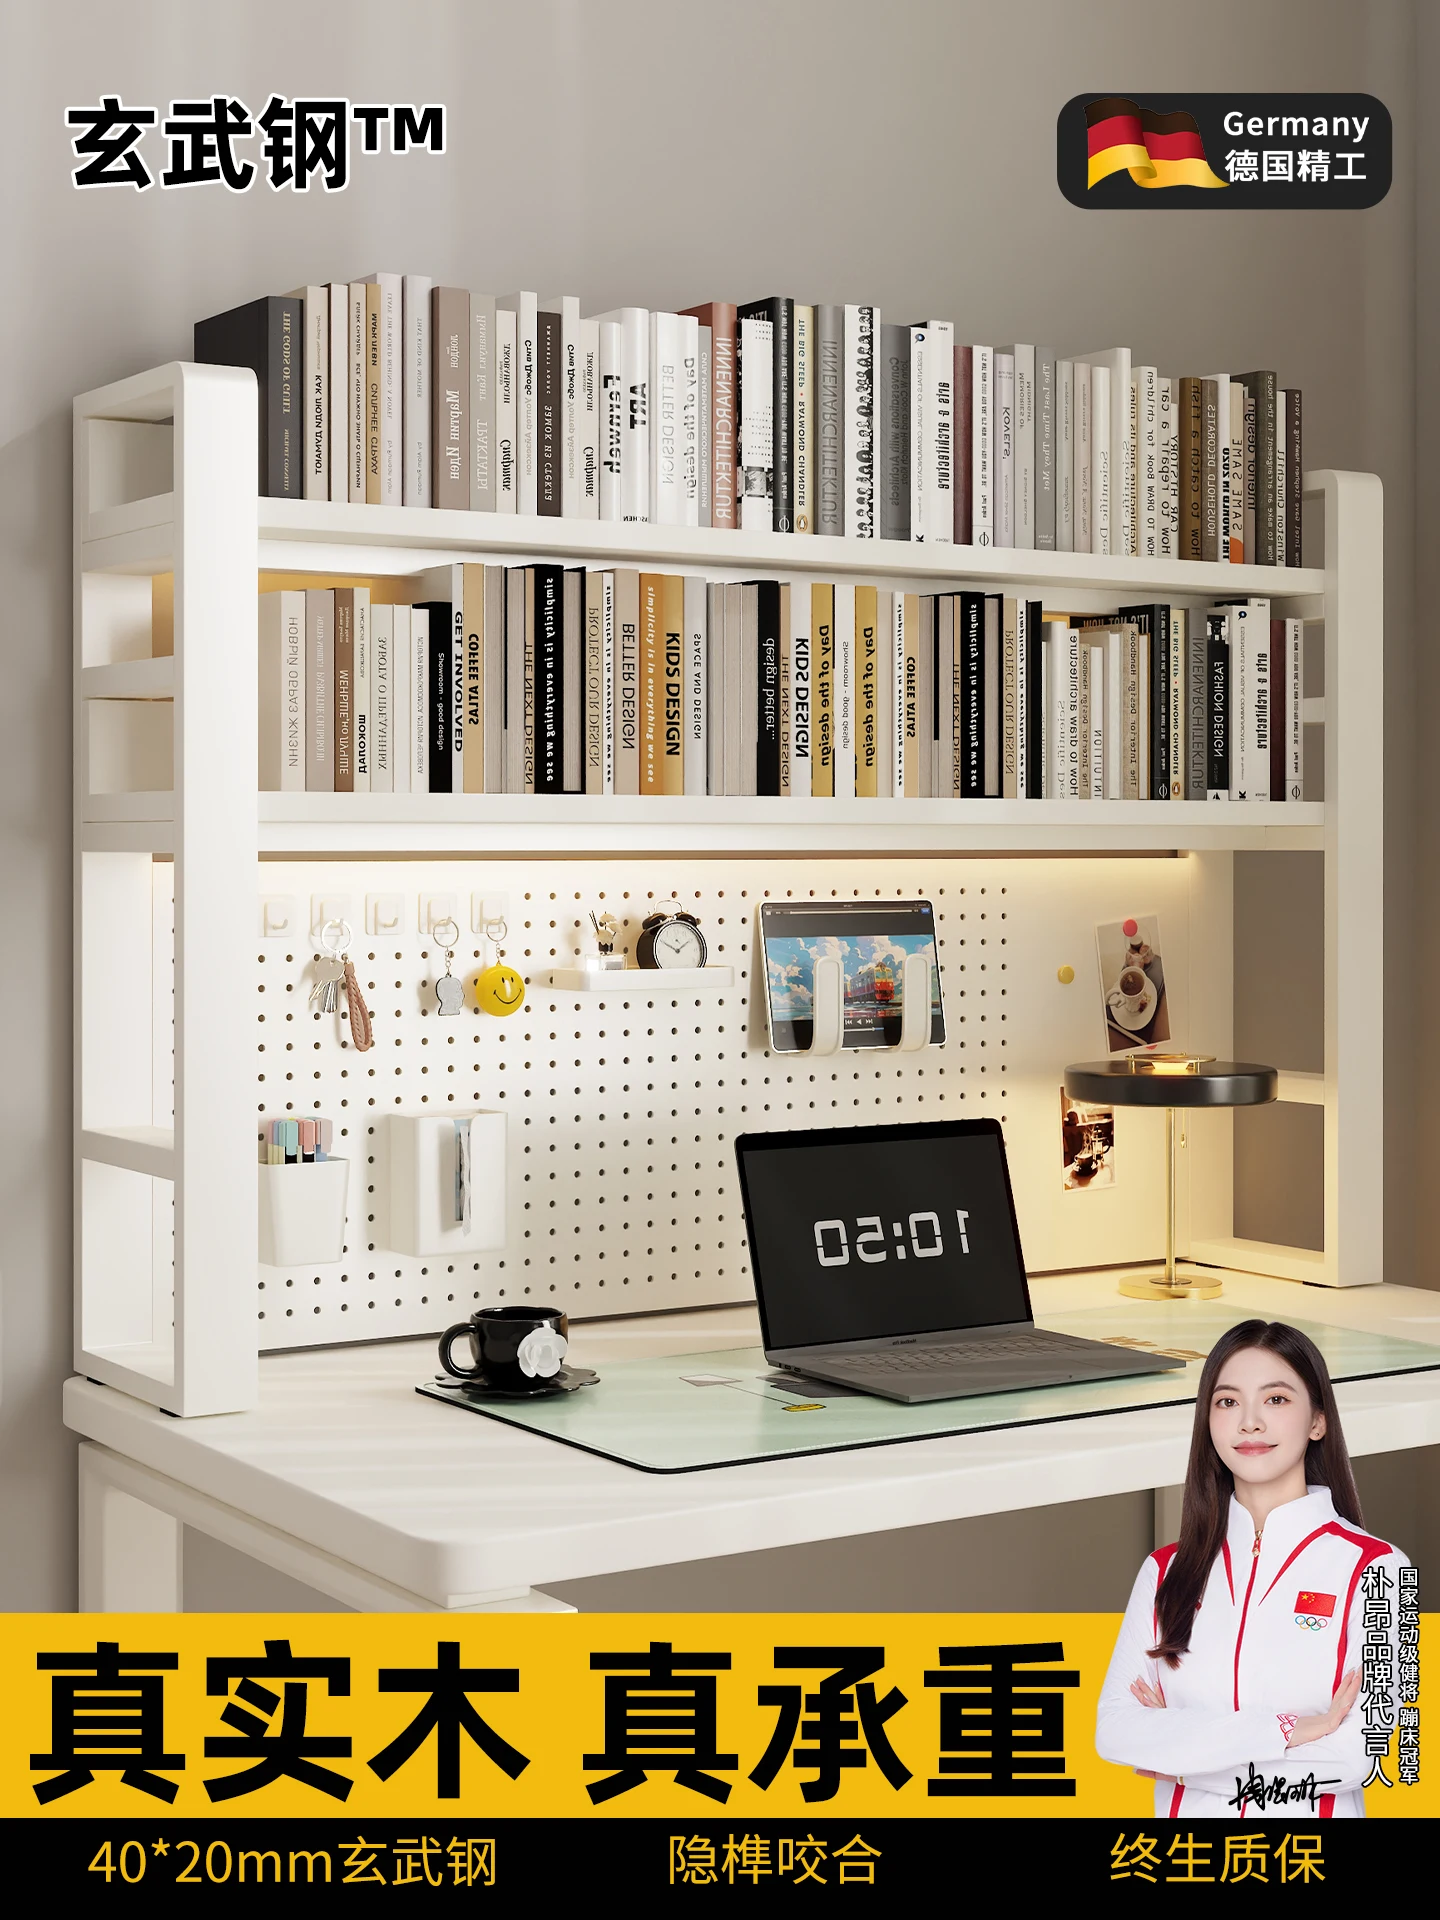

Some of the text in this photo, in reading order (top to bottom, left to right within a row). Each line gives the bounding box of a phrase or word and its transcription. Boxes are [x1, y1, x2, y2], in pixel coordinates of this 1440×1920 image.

[455, 611, 463, 752] GET INVOLVED
[666, 632, 680, 756] KIDS DESIGN
